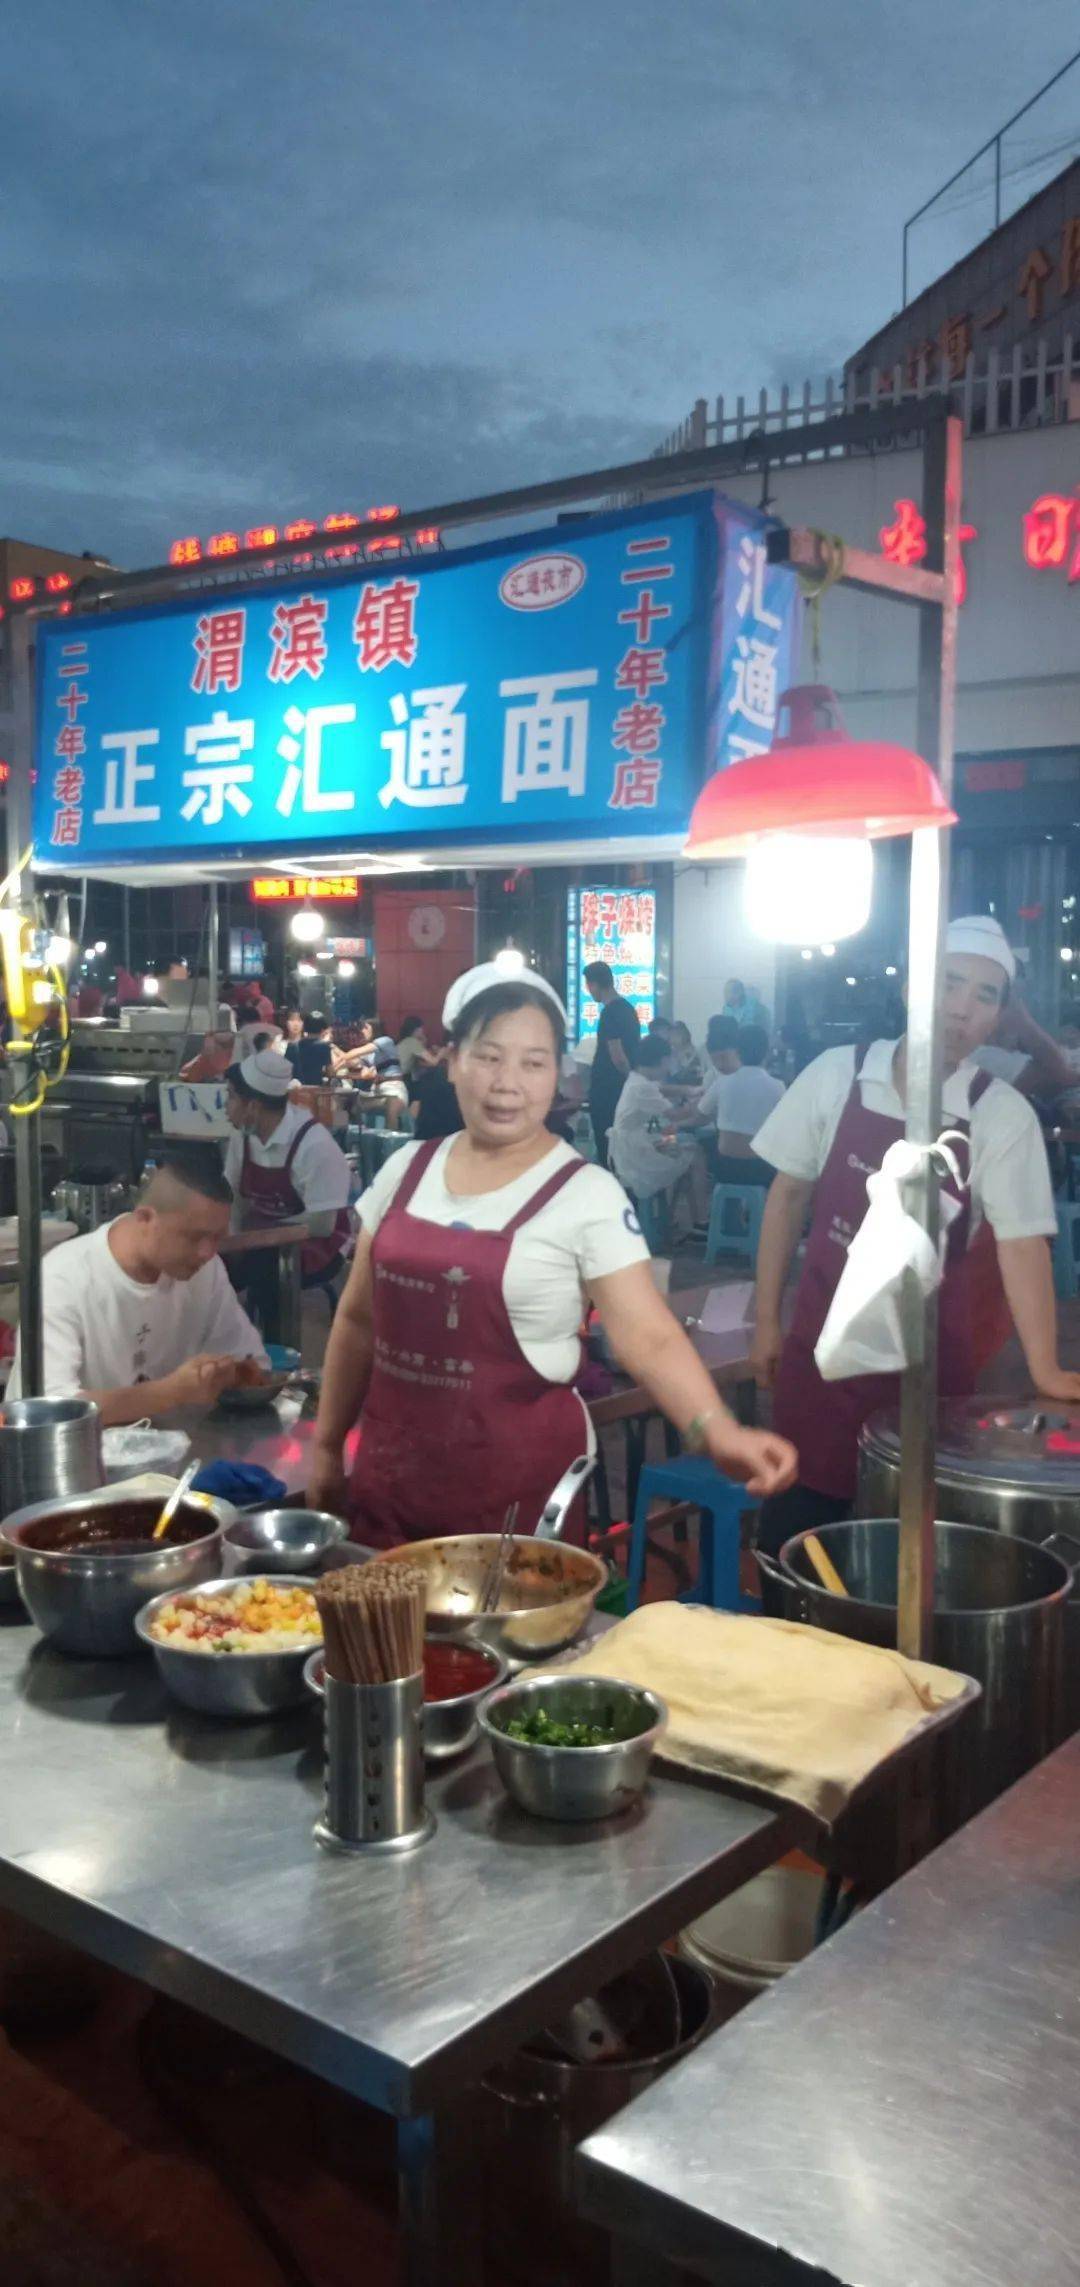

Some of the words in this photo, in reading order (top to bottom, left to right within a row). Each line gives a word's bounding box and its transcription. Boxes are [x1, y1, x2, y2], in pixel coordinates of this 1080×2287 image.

[189, 577, 423, 695] 渭滨镇
[608, 536, 675, 808] 二十年老店
[728, 536, 783, 766] 汇通
[51, 642, 89, 846] 二十年老店
[93, 669, 599, 827] 正宗汇通面
